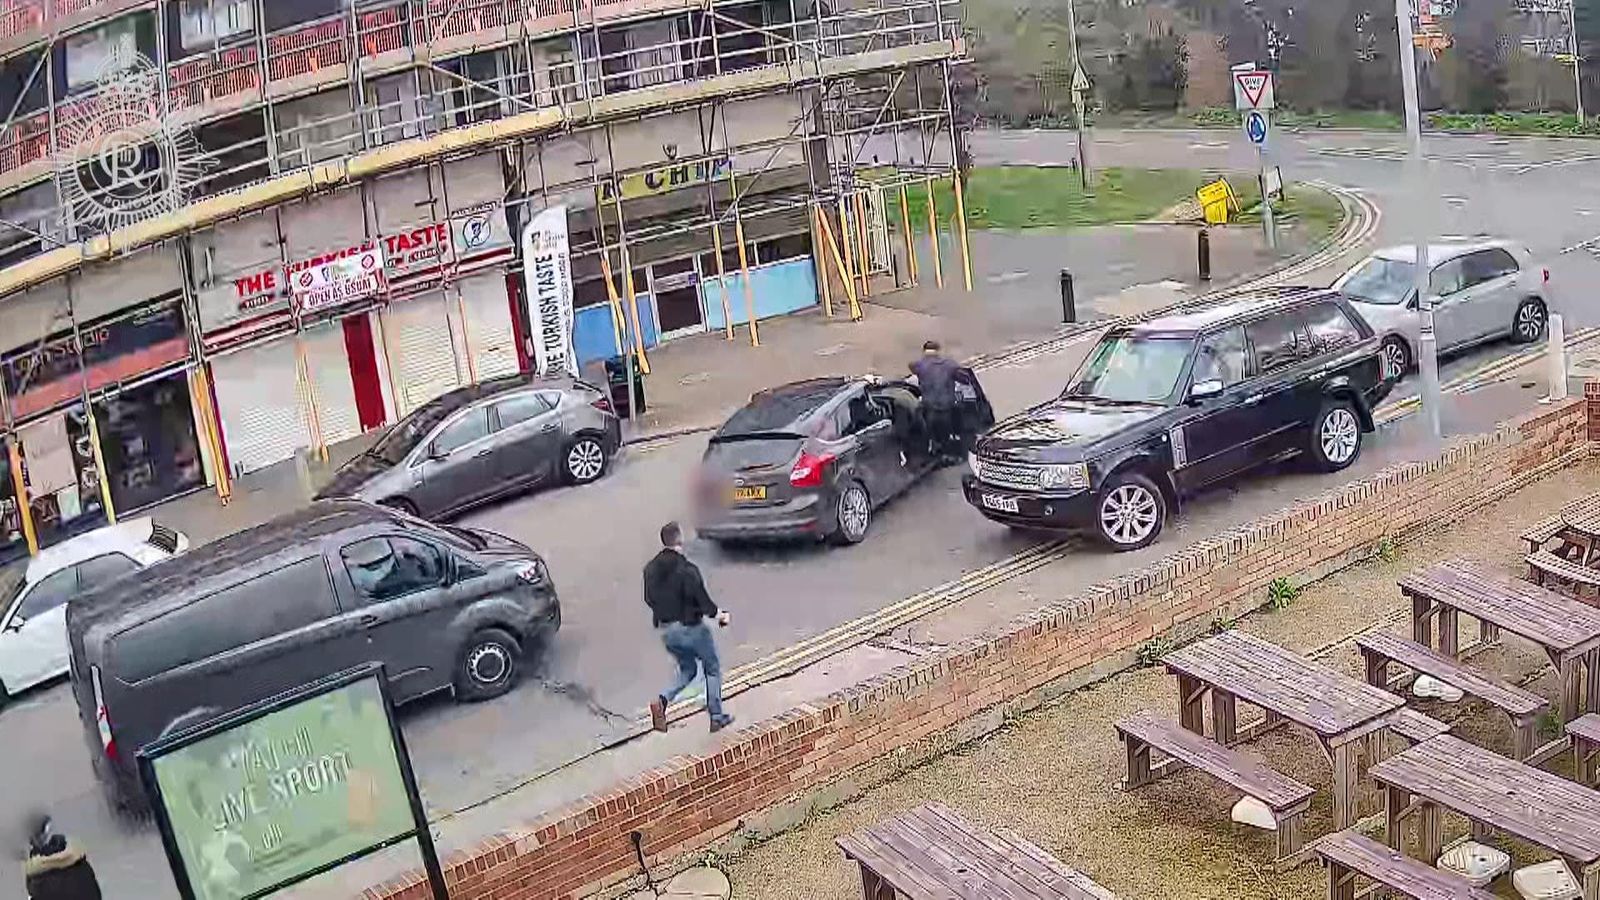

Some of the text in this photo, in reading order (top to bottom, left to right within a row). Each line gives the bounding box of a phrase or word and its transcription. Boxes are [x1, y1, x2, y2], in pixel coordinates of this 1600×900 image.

[1245, 77, 1261, 86] GIVE
[235, 271, 276, 297] THE
[386, 222, 446, 254] TASTE
[535, 254, 558, 294] TASTE
[308, 290, 331, 306] OPEN
[332, 286, 344, 300] AS
[539, 297, 563, 351] TURKISH
[271, 749, 353, 800] SPORT
